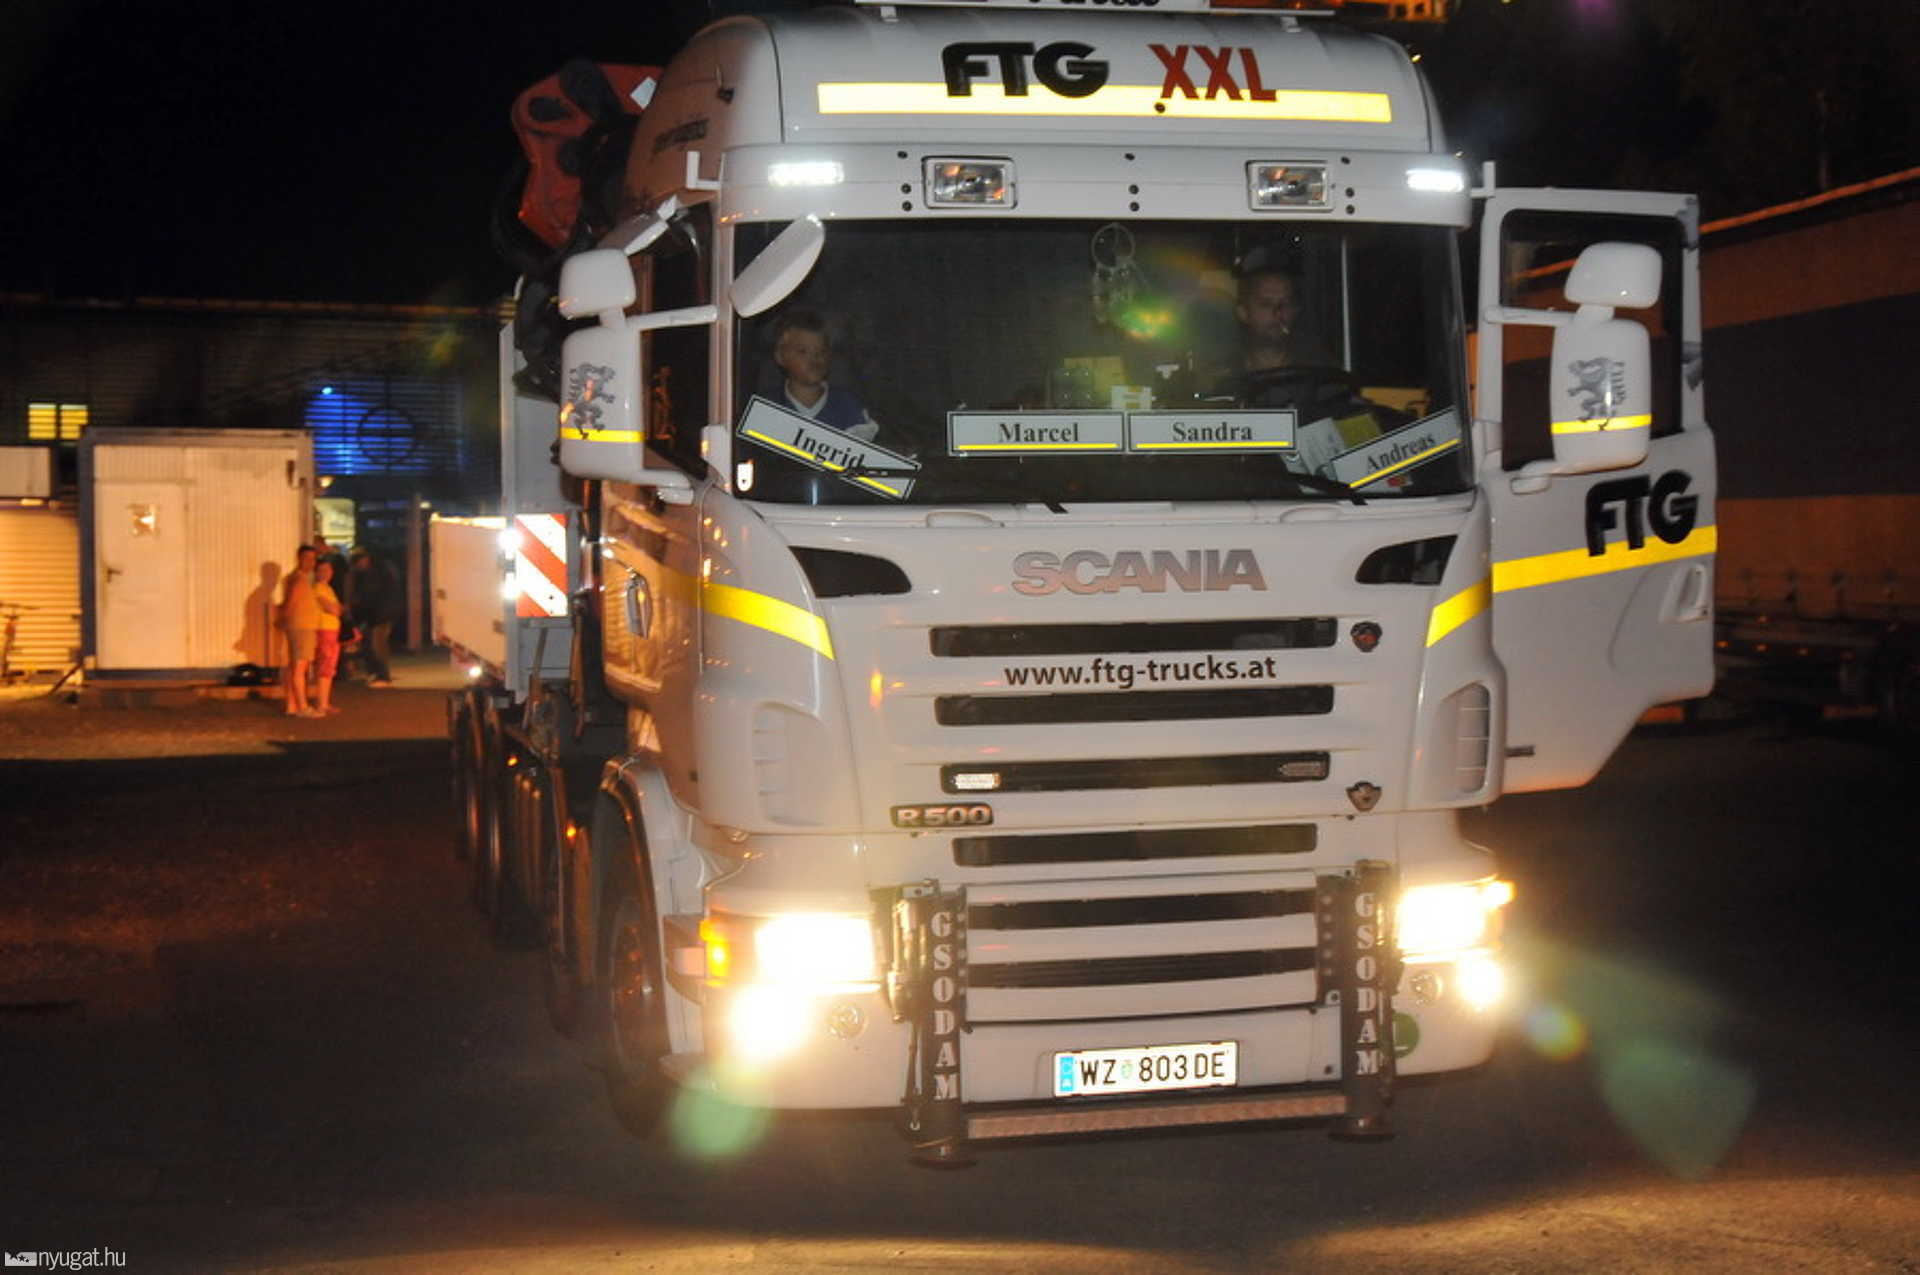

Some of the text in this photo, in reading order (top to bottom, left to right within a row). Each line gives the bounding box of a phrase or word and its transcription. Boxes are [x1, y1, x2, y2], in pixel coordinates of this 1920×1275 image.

[942, 41, 1277, 102] FTG XXL
[793, 428, 865, 473] Ingrid
[999, 422, 1080, 443] Marcel
[1172, 420, 1253, 442] Sandra
[1366, 433, 1436, 472] Andreas
[1585, 469, 1698, 557] FTG
[1011, 549, 1266, 595] SCANIA
[1004, 655, 1277, 689] www.ftg-trucks.at
[931, 912, 959, 1101] GSODAM
[1081, 1060, 1116, 1086] WZ
